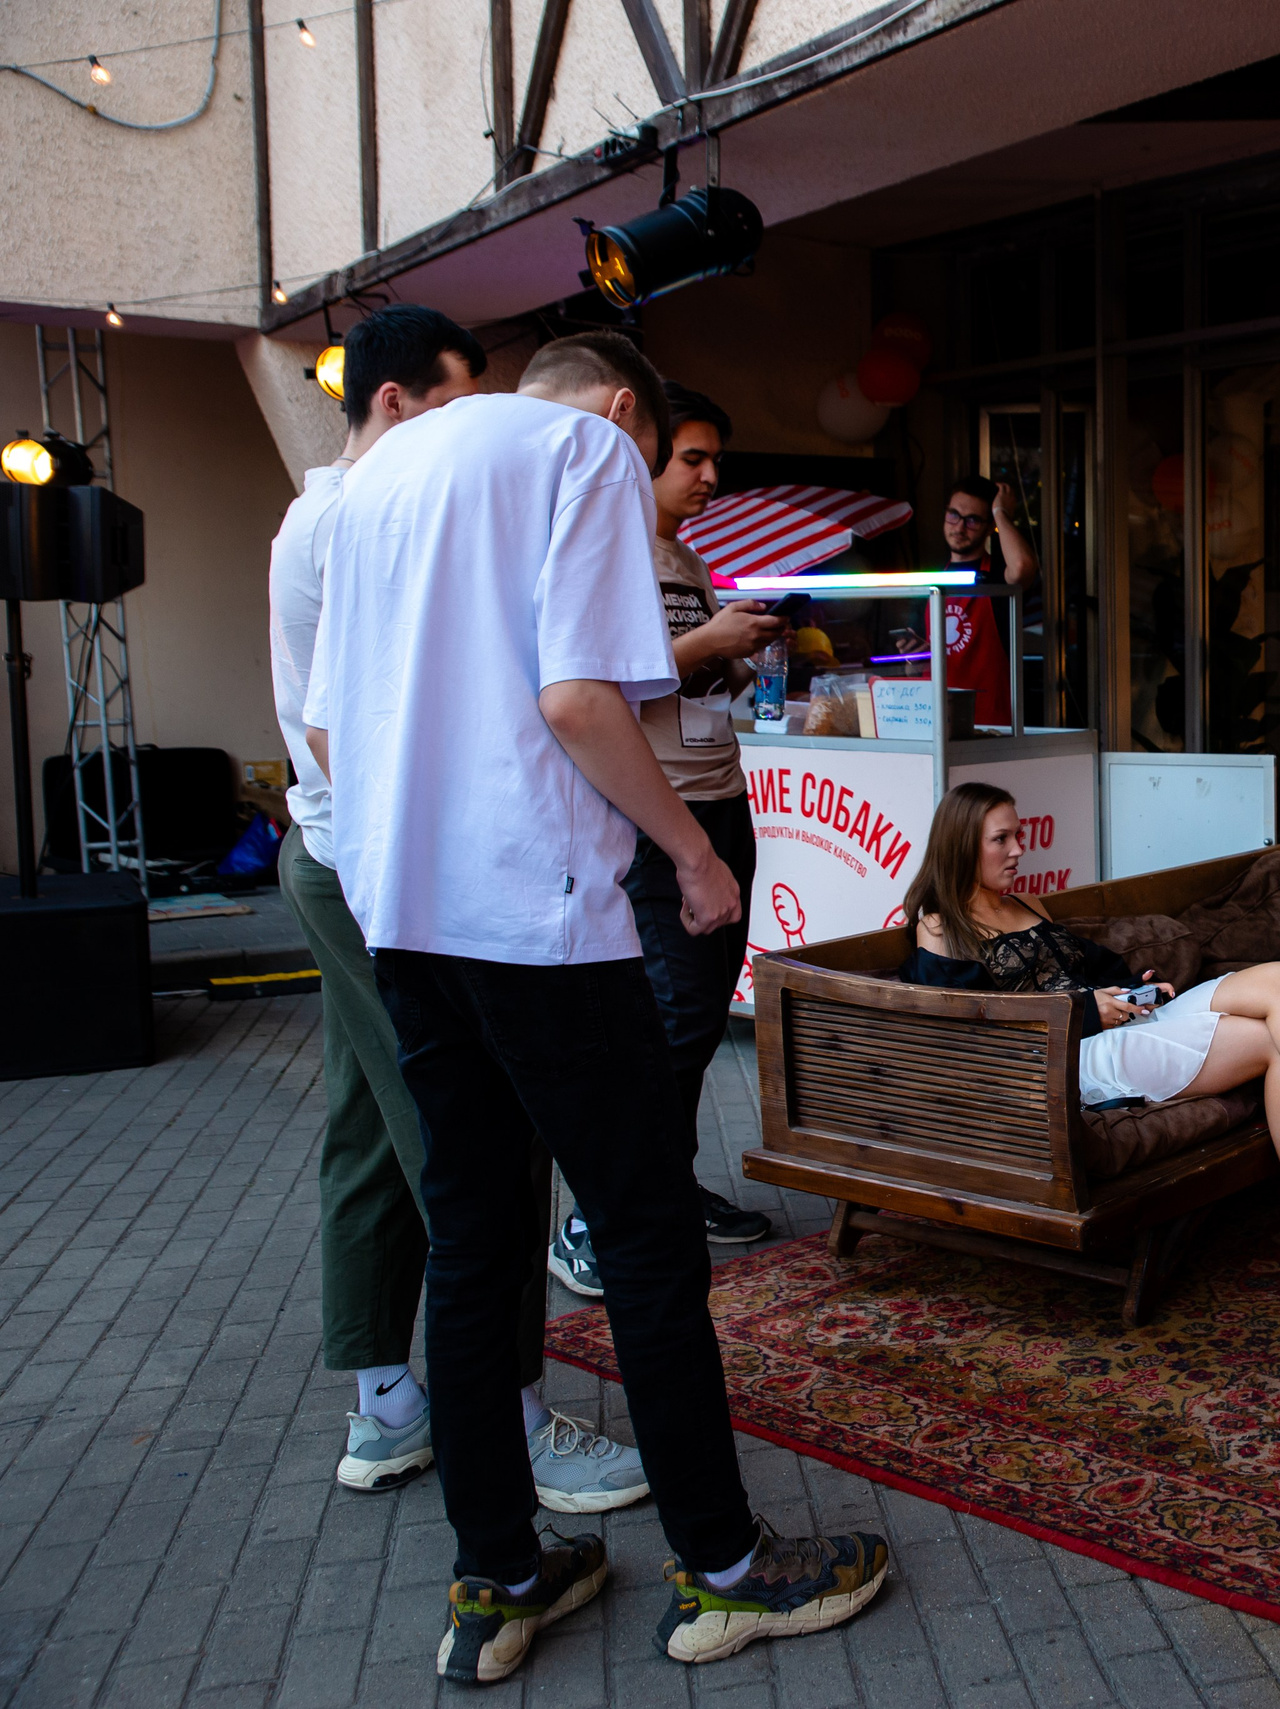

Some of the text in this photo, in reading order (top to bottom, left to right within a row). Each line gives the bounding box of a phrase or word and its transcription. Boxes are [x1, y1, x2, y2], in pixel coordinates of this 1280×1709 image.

[800, 772, 912, 880] СОБАКИ
[1015, 814, 1055, 852] ЕТО
[759, 825, 794, 840] ПРОДУКТЫ
[795, 829, 801, 841] И
[801, 830, 833, 854] ВЫСОКОЕ
[833, 844, 868, 878] КАЧЕСТВО
[1001, 867, 1073, 897] ЯНСК
